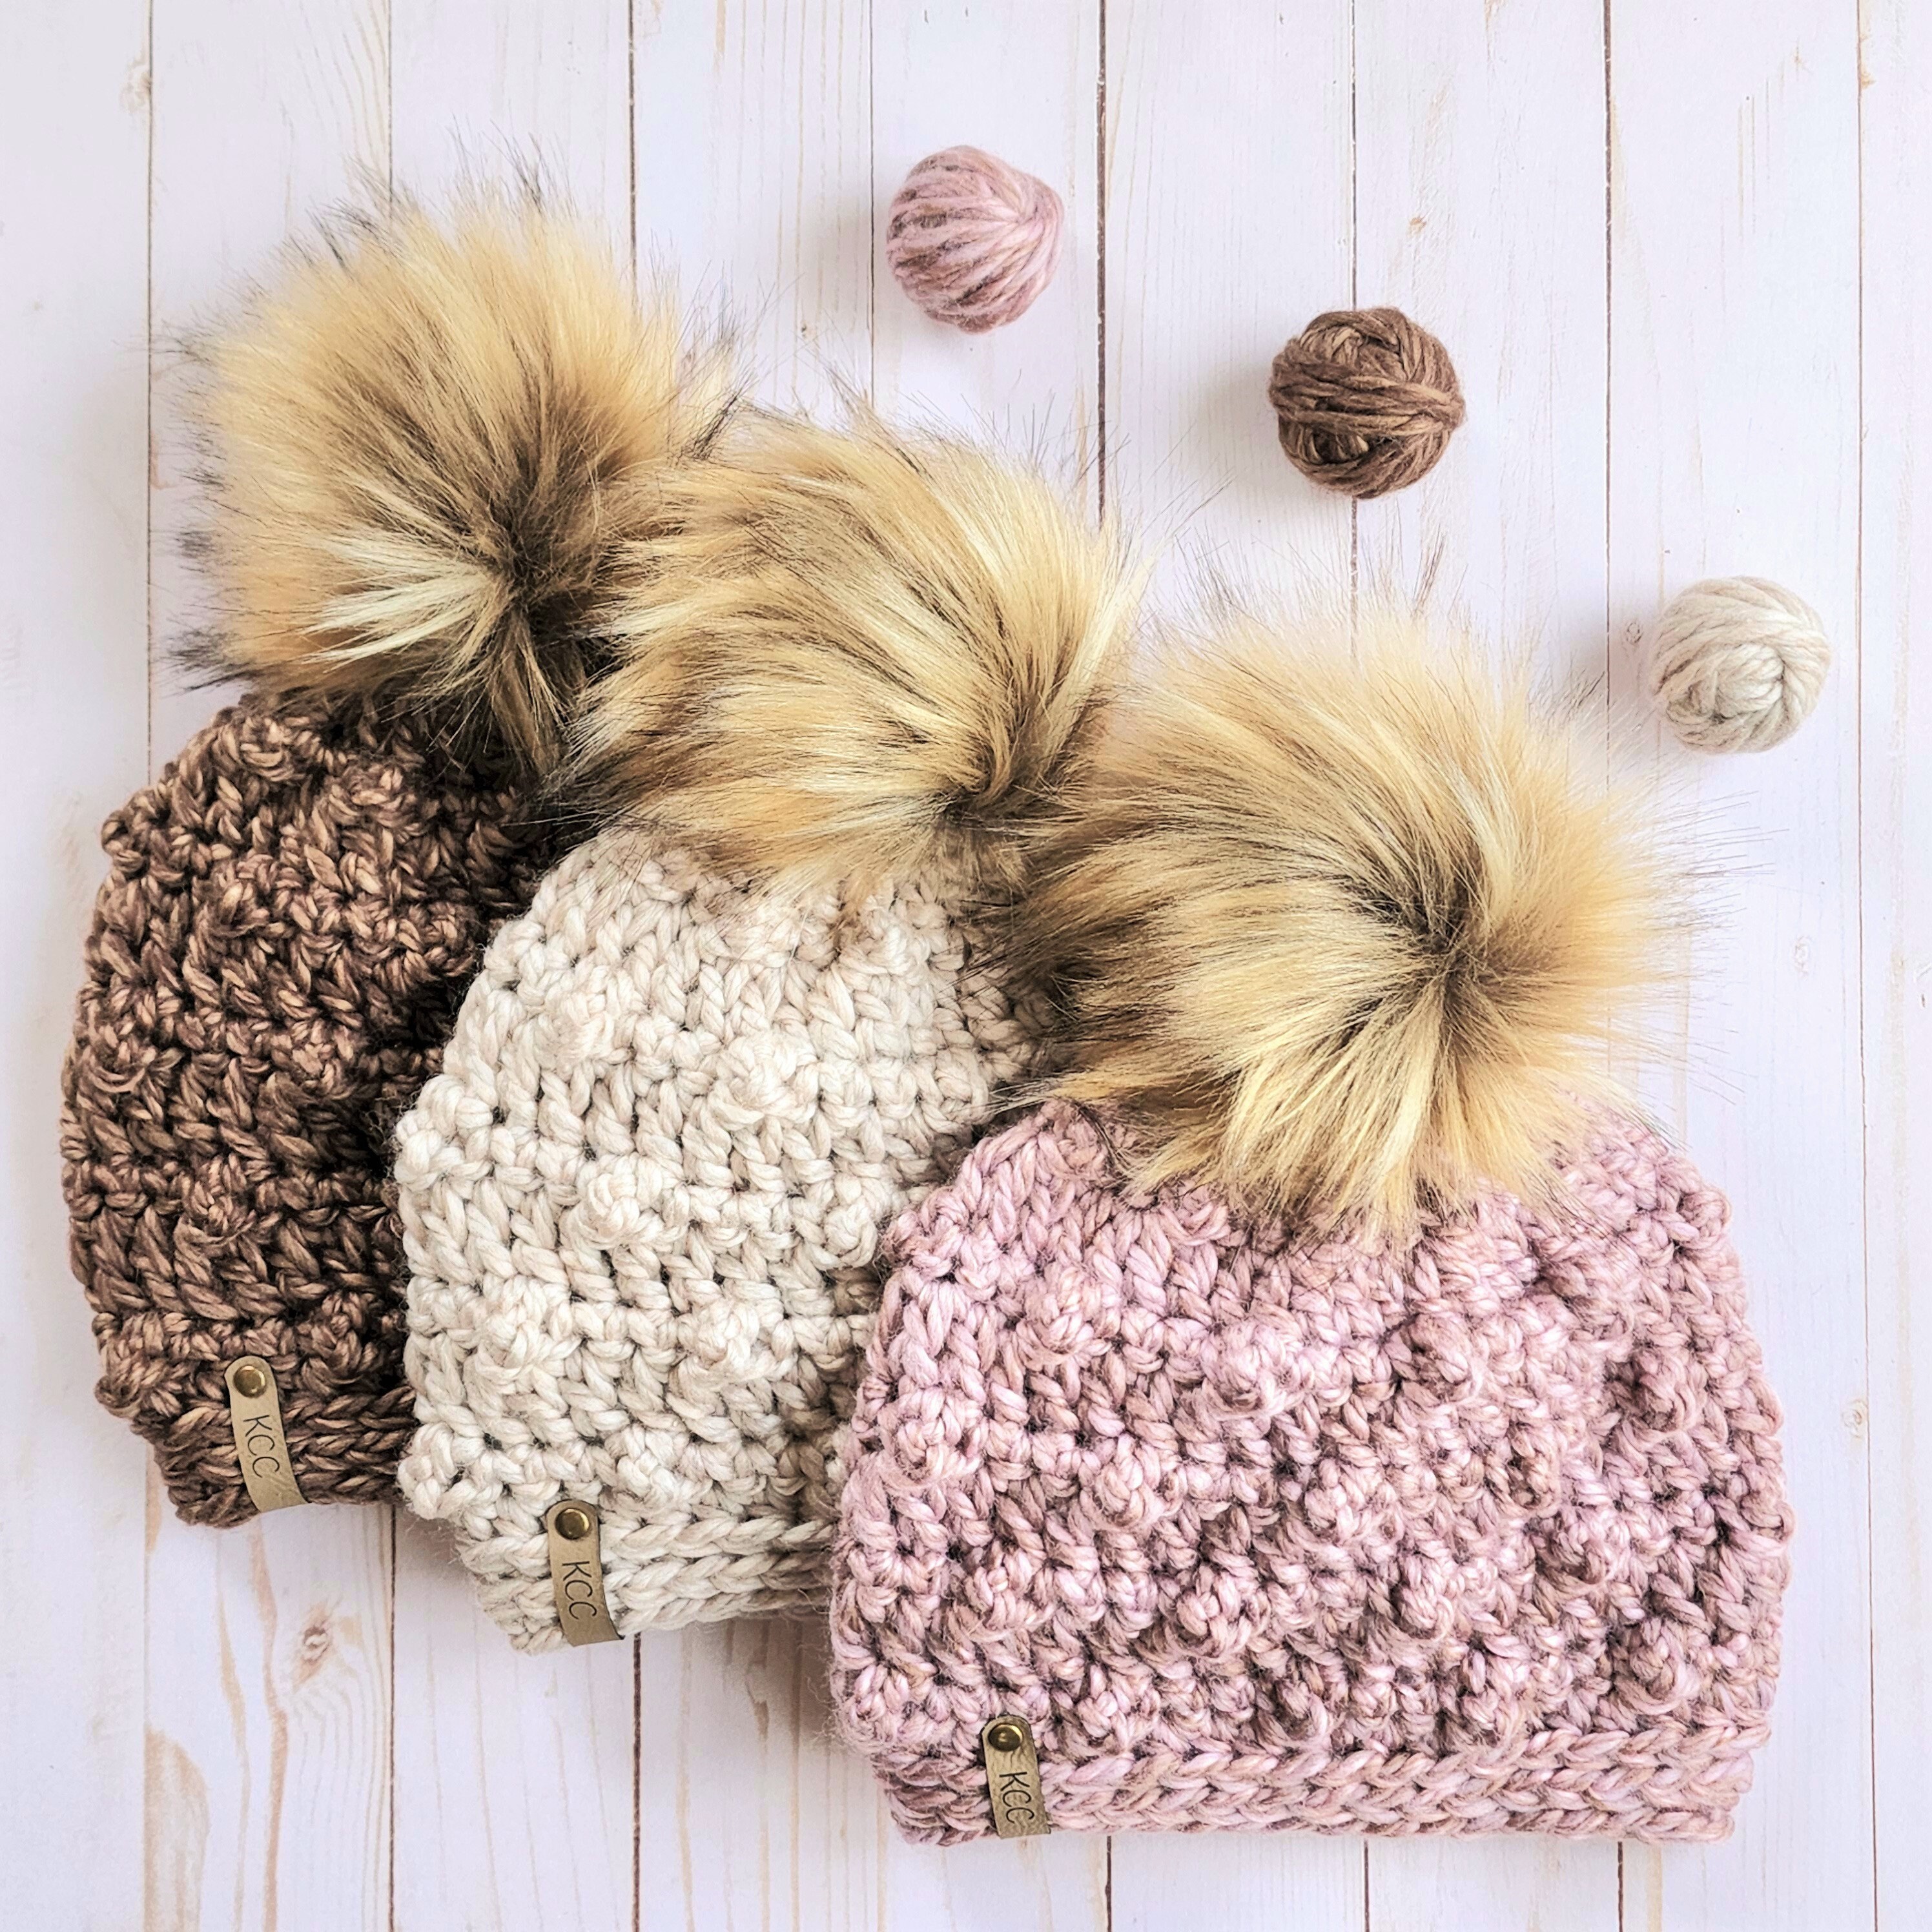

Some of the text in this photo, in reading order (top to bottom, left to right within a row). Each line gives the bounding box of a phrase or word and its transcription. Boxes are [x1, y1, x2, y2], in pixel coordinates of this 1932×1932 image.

[243, 1414, 280, 1478] KCC
[562, 1561, 597, 1620] KCC
[999, 1771, 1035, 1824] KCC
